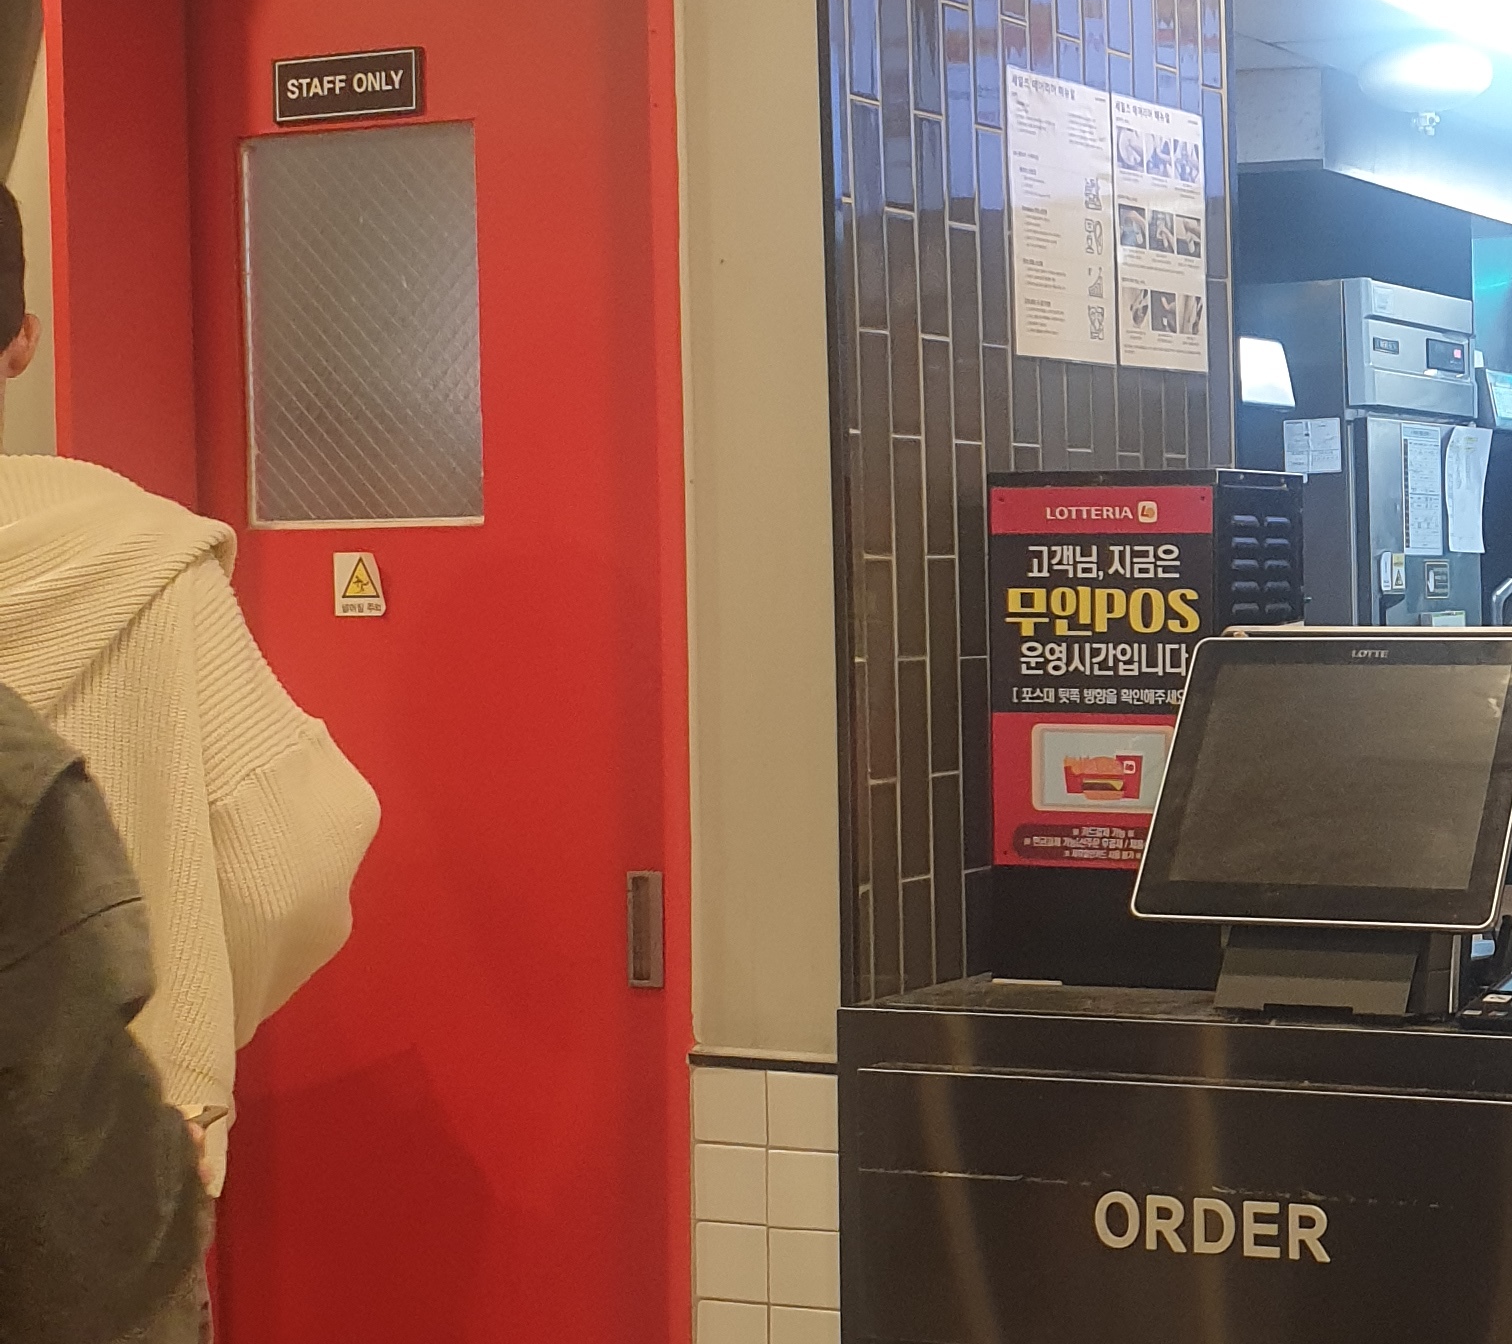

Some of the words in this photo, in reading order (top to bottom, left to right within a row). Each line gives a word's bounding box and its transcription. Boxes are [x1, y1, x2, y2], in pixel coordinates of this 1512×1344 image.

[287, 75, 347, 99] STAFF
[353, 69, 404, 93] ONLY
[1046, 506, 1133, 520] LOTTERIA
[1027, 544, 1105, 581] 고객님,
[1108, 545, 1181, 579] 지금은
[1005, 586, 1200, 637] 무인POS
[1019, 641, 1188, 676] 운영시간입니다
[1352, 650, 1389, 658] LOTTE
[1084, 688, 1117, 704] 방향을
[1094, 1190, 1331, 1263] ORDER
